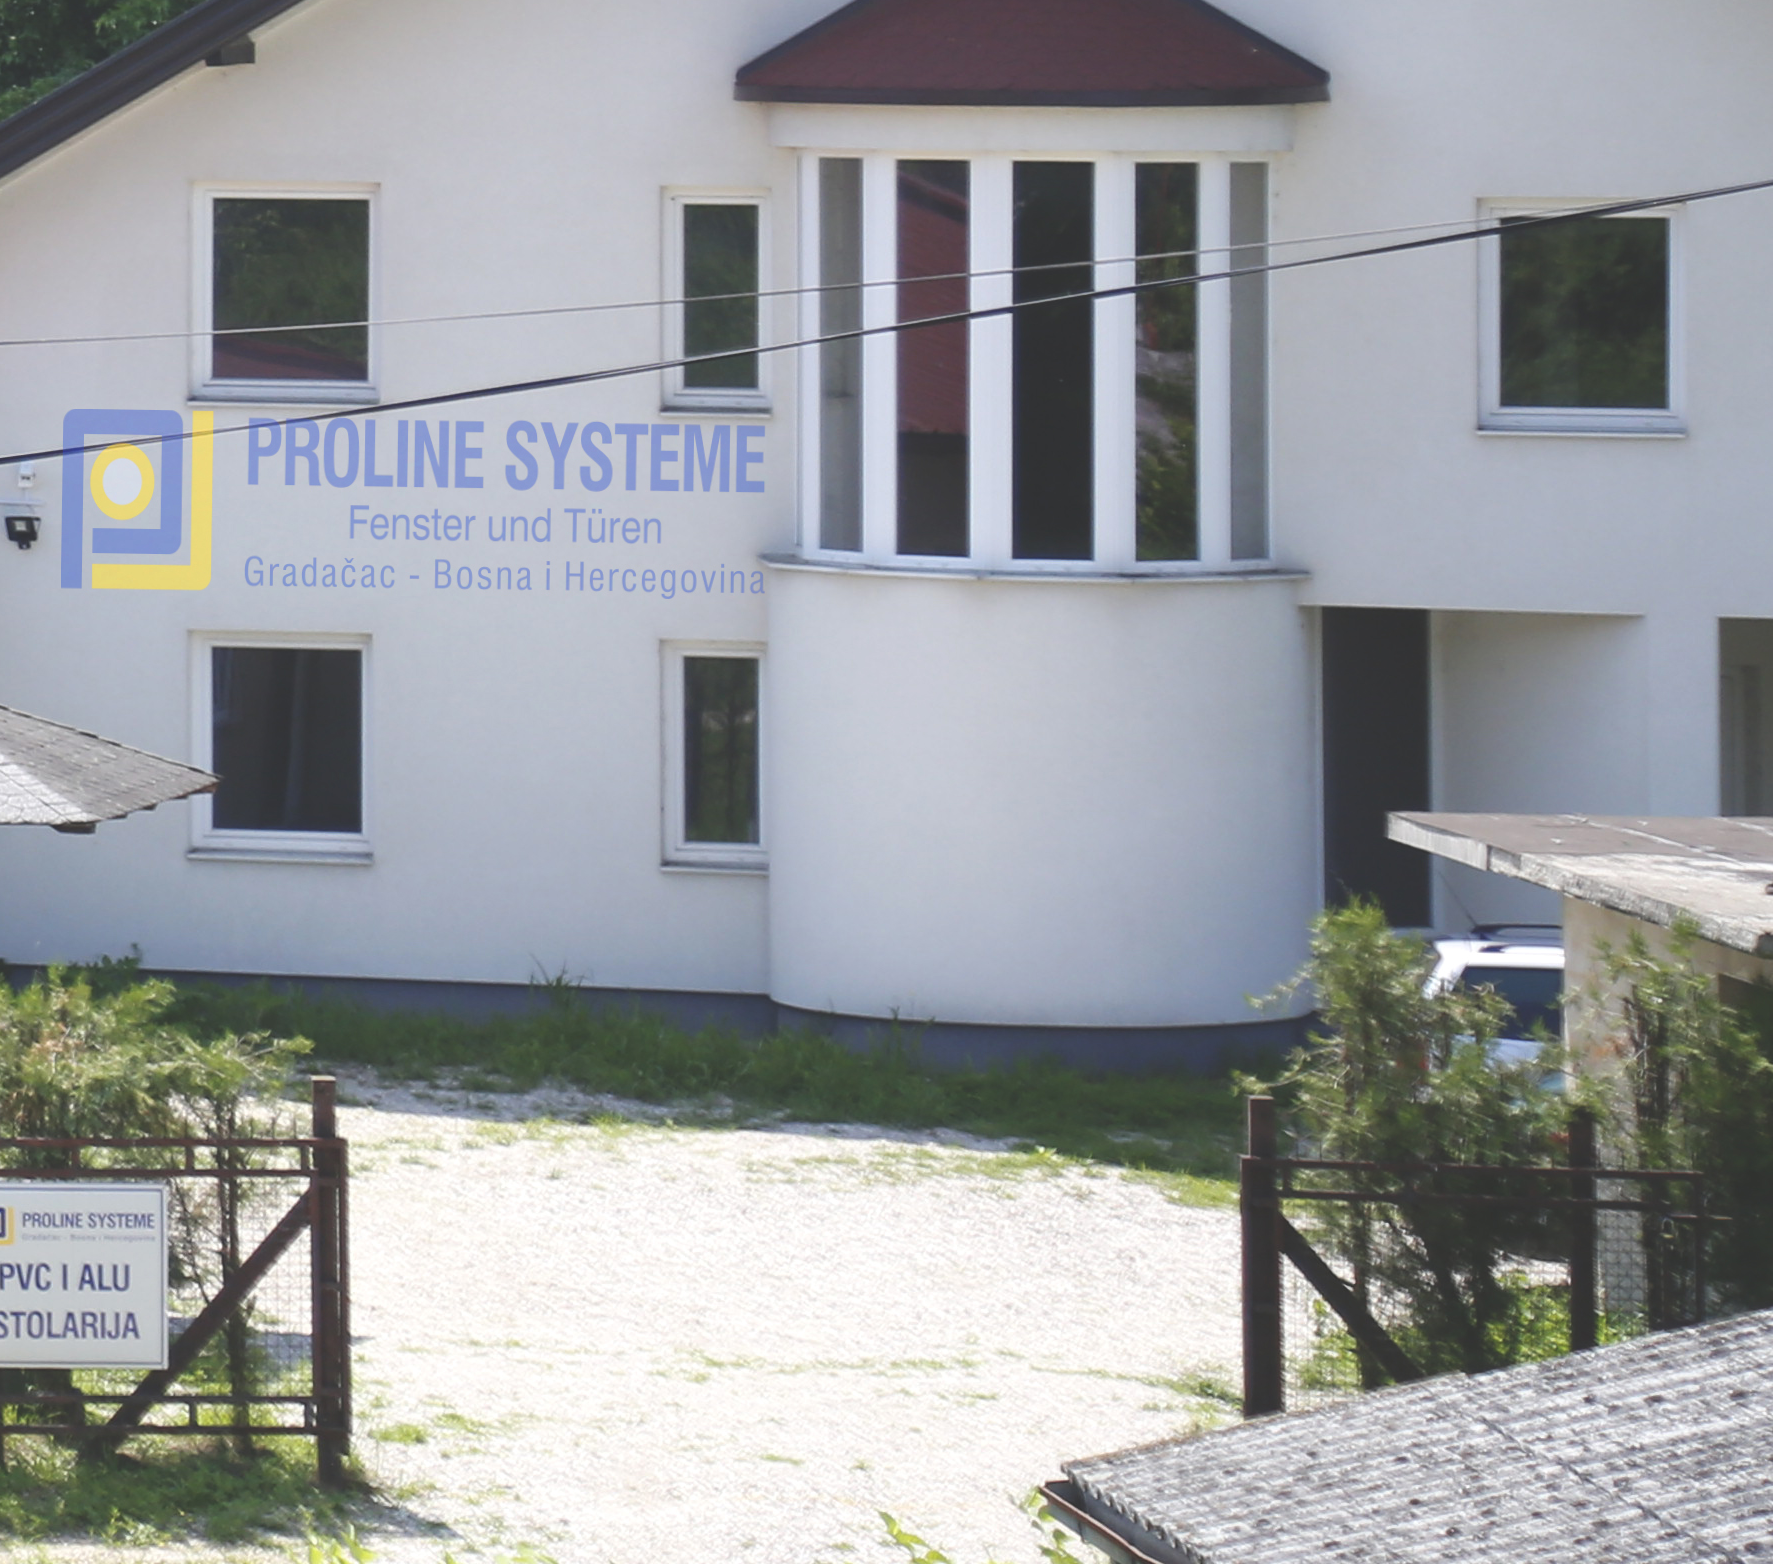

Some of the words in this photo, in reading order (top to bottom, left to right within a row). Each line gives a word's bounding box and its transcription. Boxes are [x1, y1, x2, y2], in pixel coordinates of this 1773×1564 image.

[248, 418, 484, 488] PROLINE
[506, 421, 765, 492] SYSTEME
[350, 505, 475, 541] Fenster
[489, 508, 551, 542] und
[564, 509, 661, 543] Türen
[245, 556, 394, 588] Gradačac
[435, 559, 532, 590] Bosna
[546, 561, 550, 590] i
[566, 562, 764, 599] Hercegovina
[23, 1213, 82, 1228] PROLINE
[88, 1213, 154, 1228] SYSTEME
[0, 1263, 51, 1291] PVC
[62, 1264, 67, 1290] I
[78, 1264, 129, 1291] ALU
